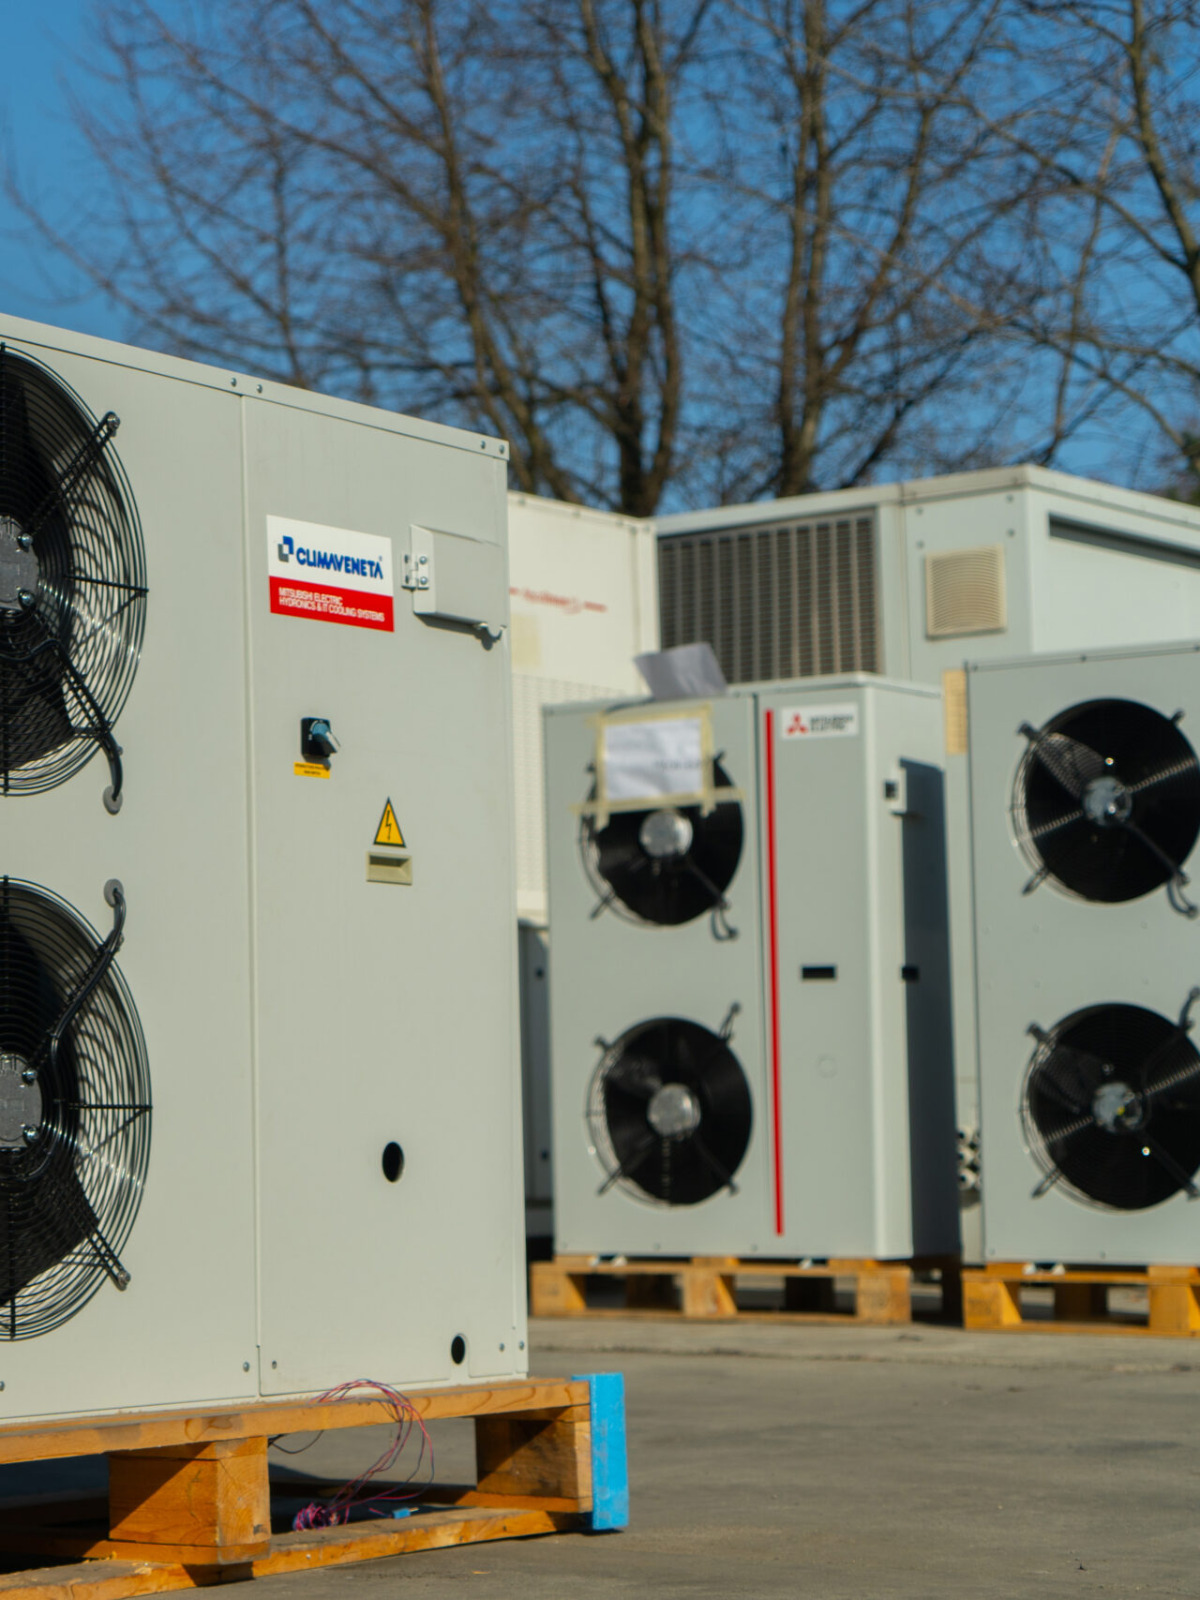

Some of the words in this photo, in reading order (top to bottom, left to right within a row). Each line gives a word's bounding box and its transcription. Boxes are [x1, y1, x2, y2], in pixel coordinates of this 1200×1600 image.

[296, 547, 383, 579] CLIMAVENETA
[329, 604, 357, 617] COOLING
[357, 608, 385, 622] SYSTEMS
